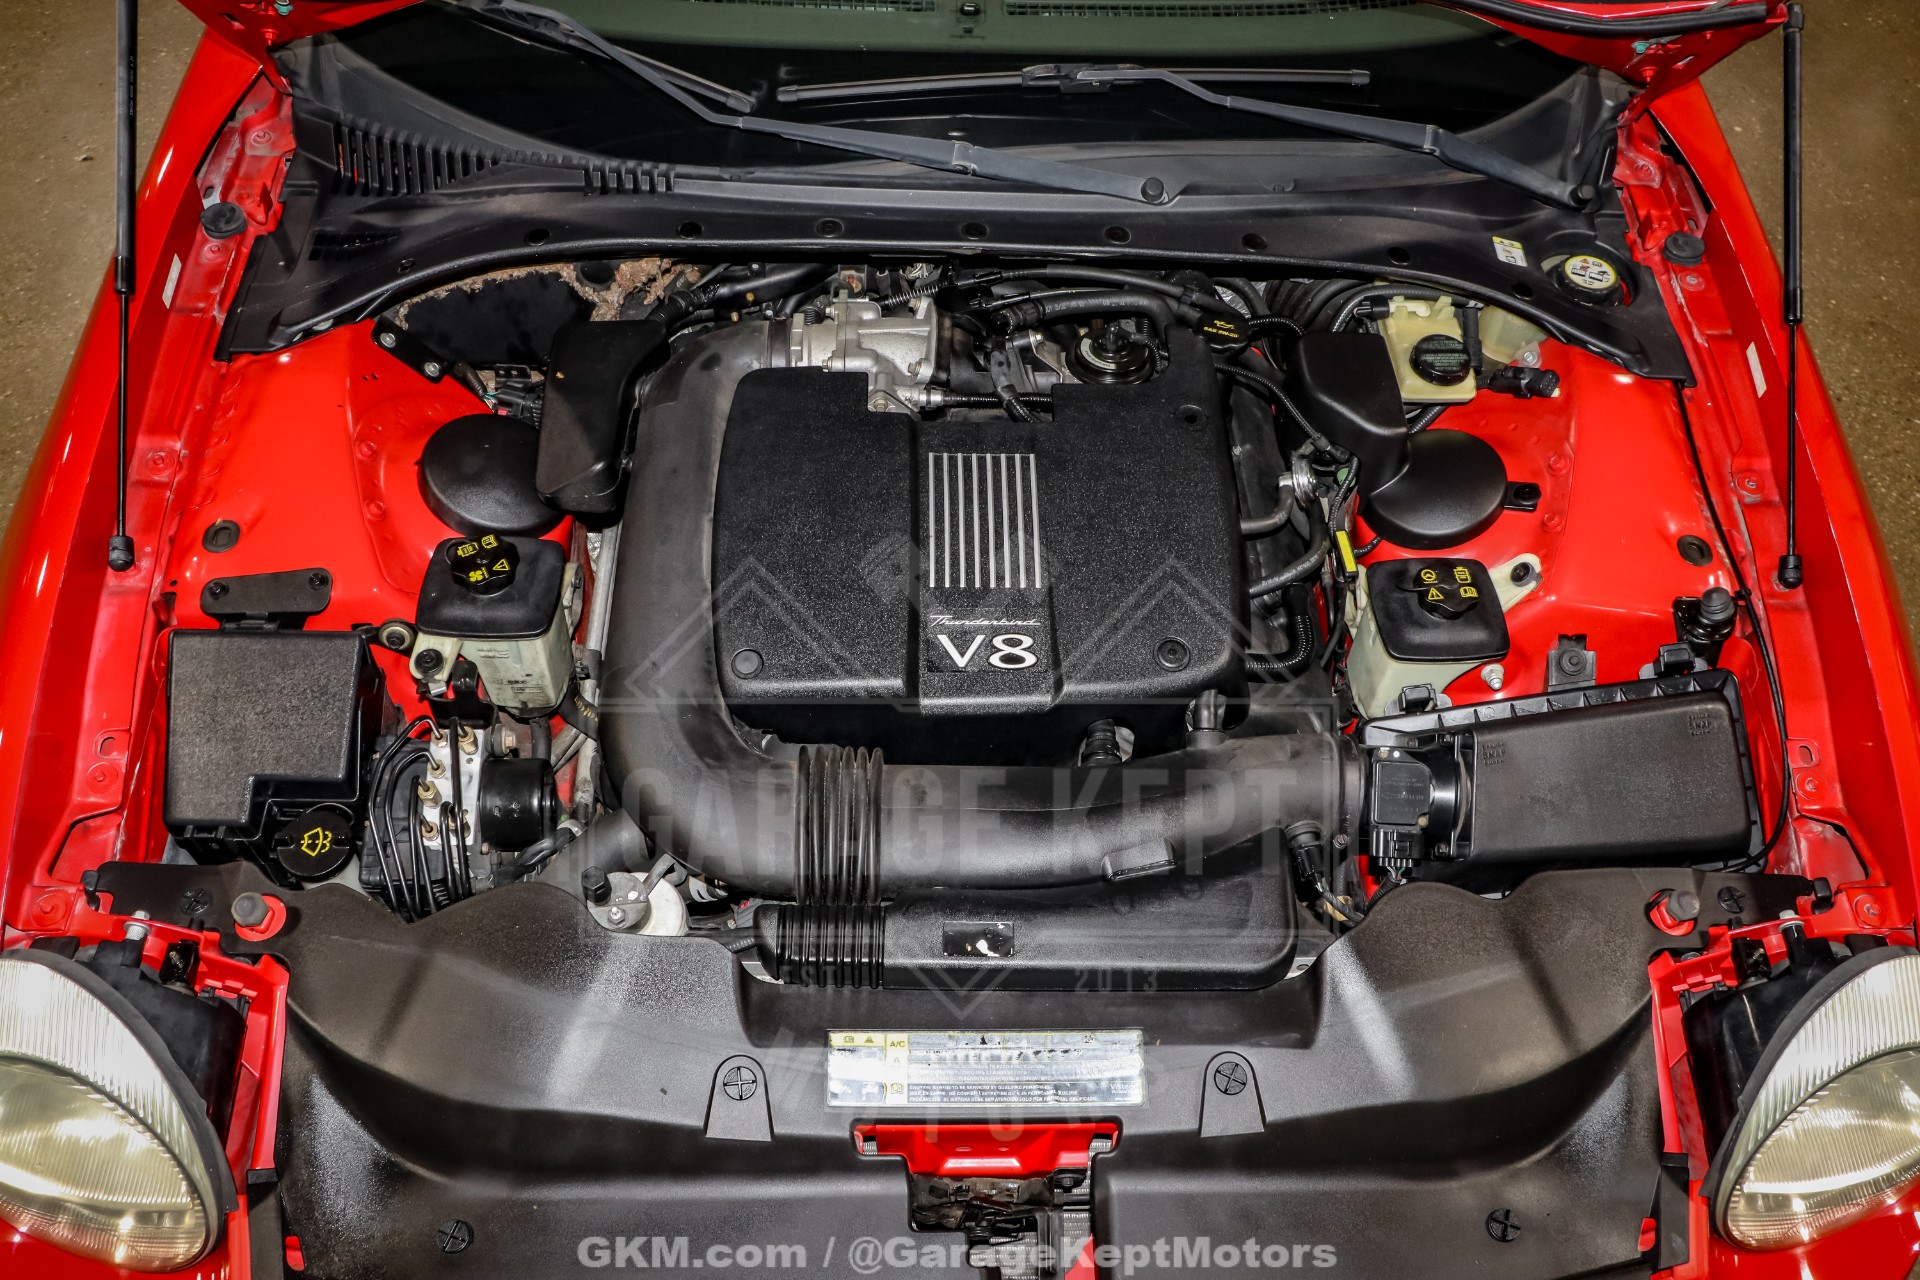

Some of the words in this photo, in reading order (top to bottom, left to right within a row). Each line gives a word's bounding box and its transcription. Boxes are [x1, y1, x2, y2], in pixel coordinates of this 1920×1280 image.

[929, 614, 1042, 628] Thunderbird
[936, 632, 1038, 669] V8
[889, 1040, 906, 1048] A/C
